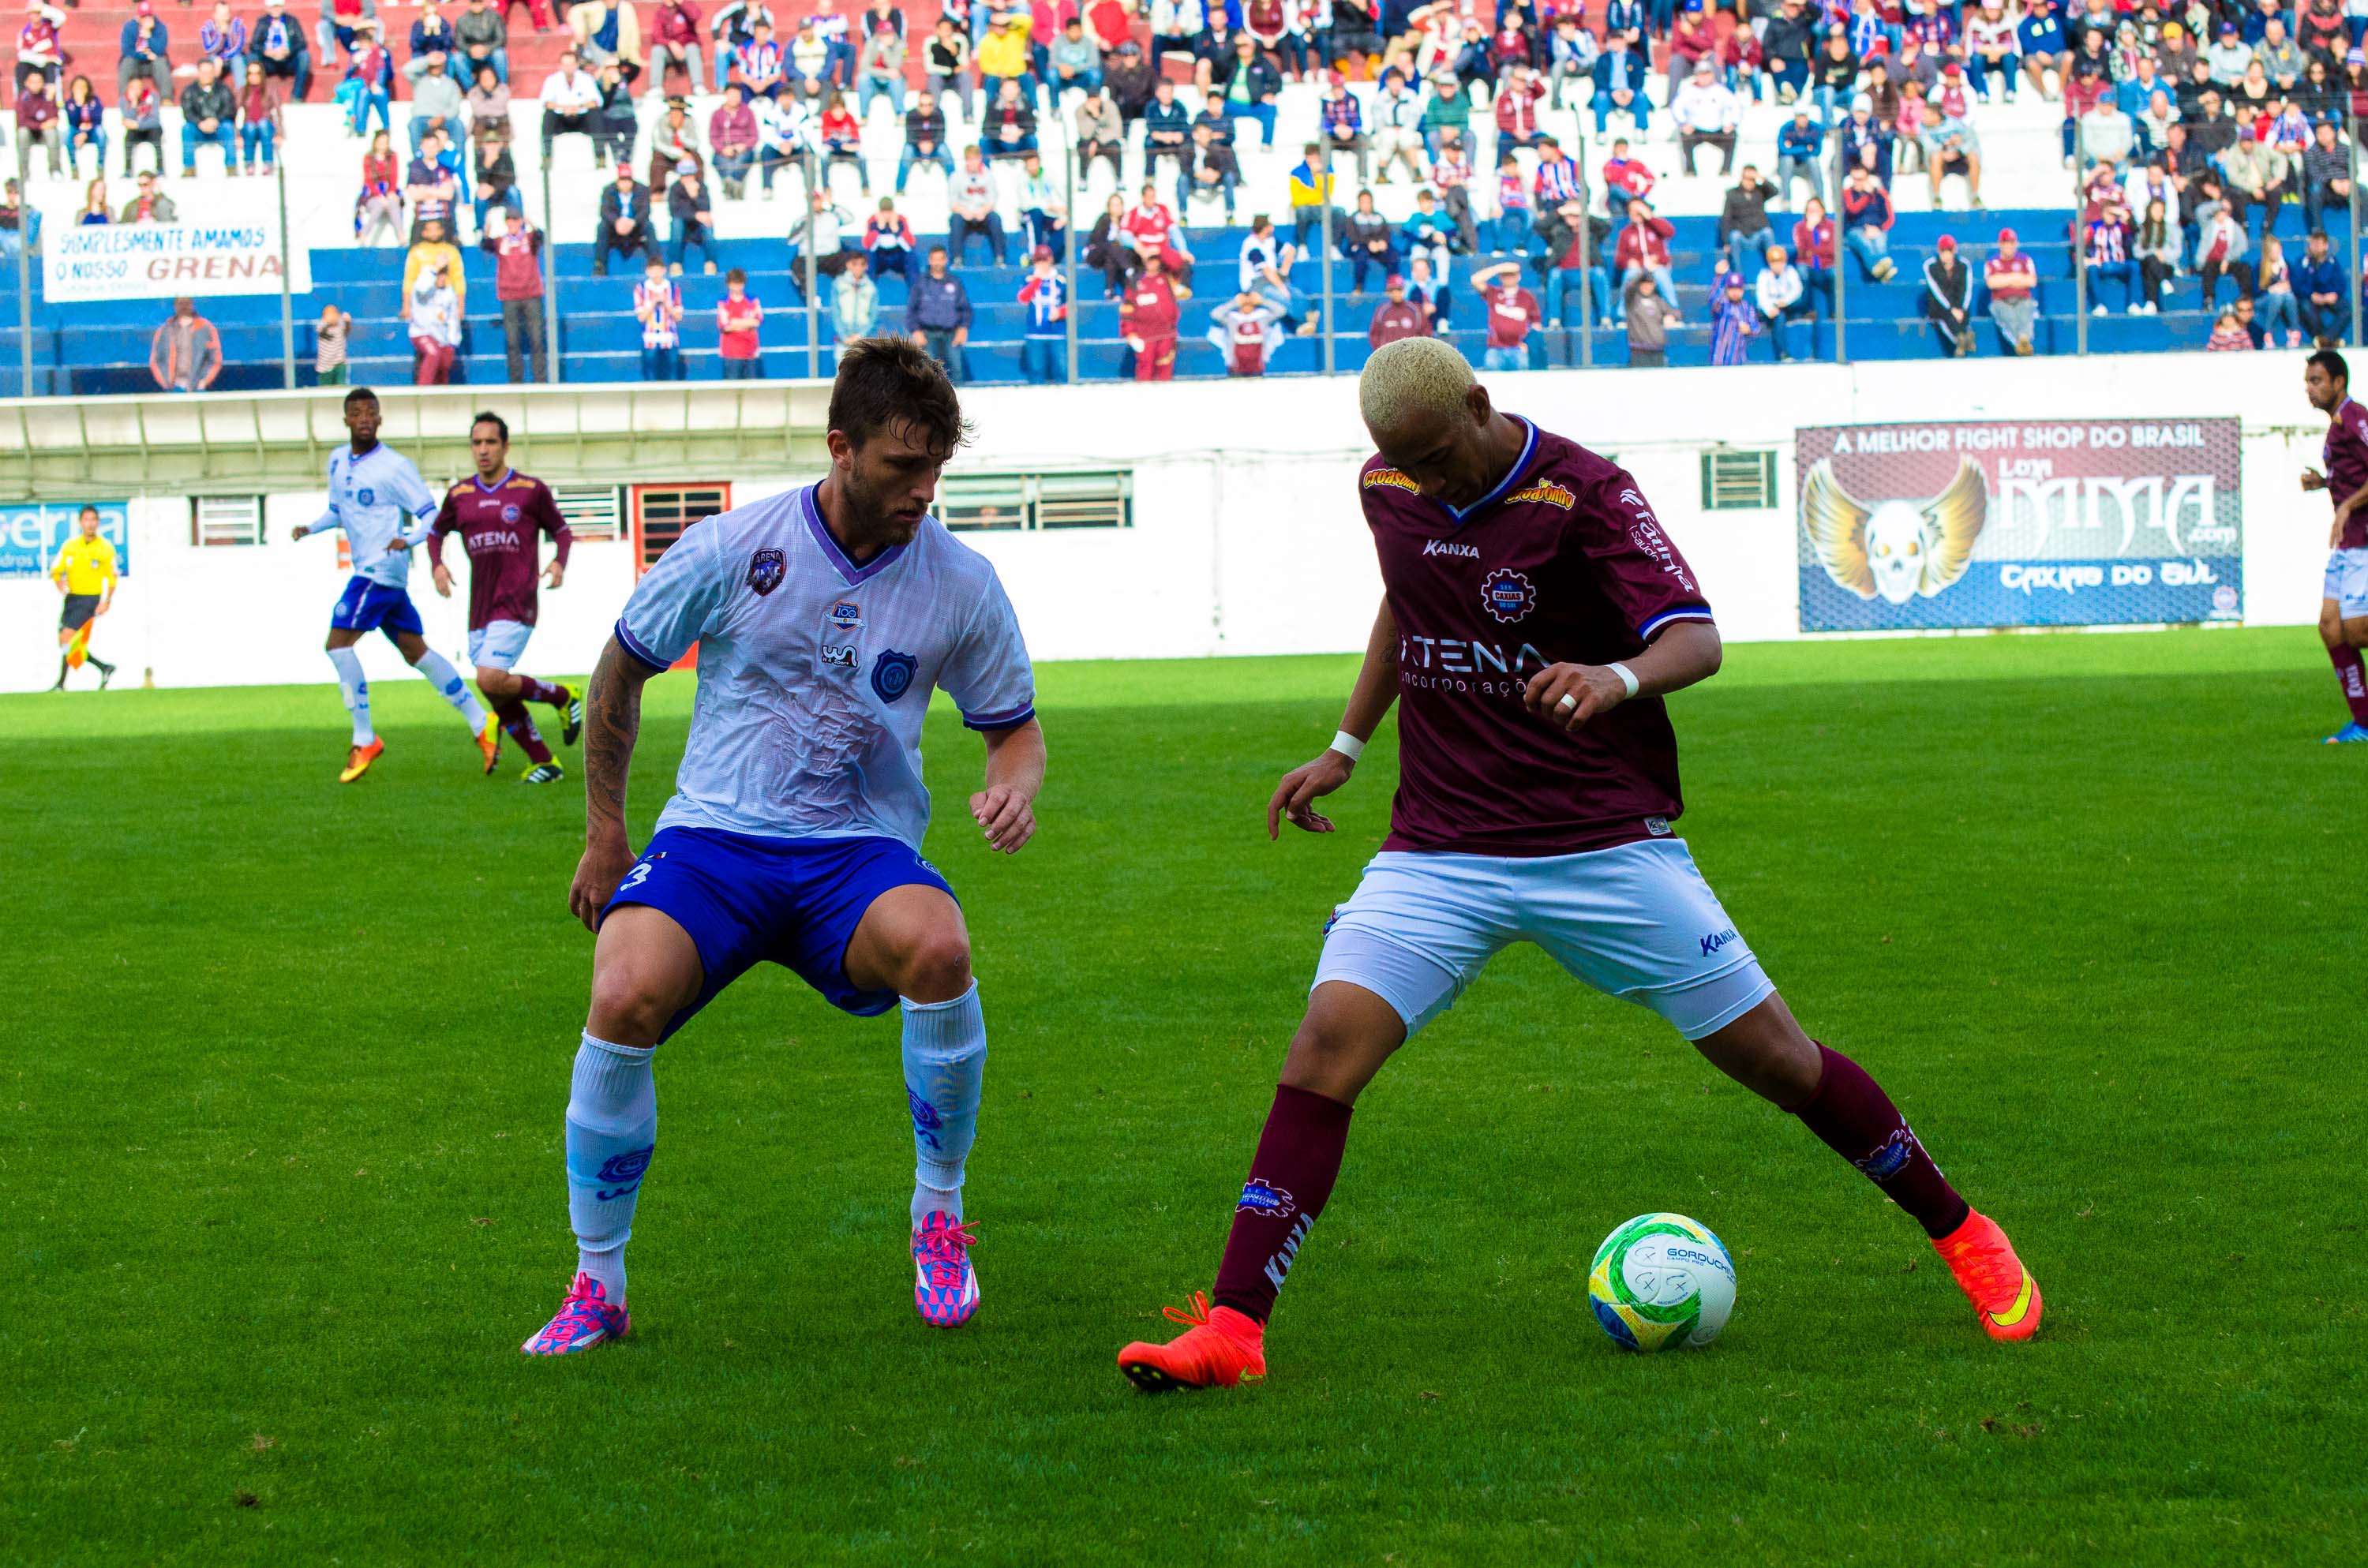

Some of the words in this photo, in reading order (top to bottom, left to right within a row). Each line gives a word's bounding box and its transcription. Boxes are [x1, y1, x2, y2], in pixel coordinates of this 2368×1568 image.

[192, 227, 265, 249] AMAMOS
[73, 260, 128, 278] NOSSO
[1834, 432, 1853, 454] A
[1857, 429, 1950, 453] MELHOR
[1954, 427, 2019, 451] FIGHT
[2022, 426, 2085, 449] SHOP
[2089, 426, 2126, 448] DO
[2130, 424, 2206, 447] BRASIL
[1998, 475, 2216, 559] MMA
[468, 531, 519, 550] ATENA
[1422, 539, 1480, 559] KANXA
[755, 551, 784, 563] ARENA
[837, 608, 856, 618] 100
[1402, 671, 1529, 697] incorporaçõ
[1700, 929, 1737, 957] KANXA
[1264, 1212, 1314, 1294] KANXA
